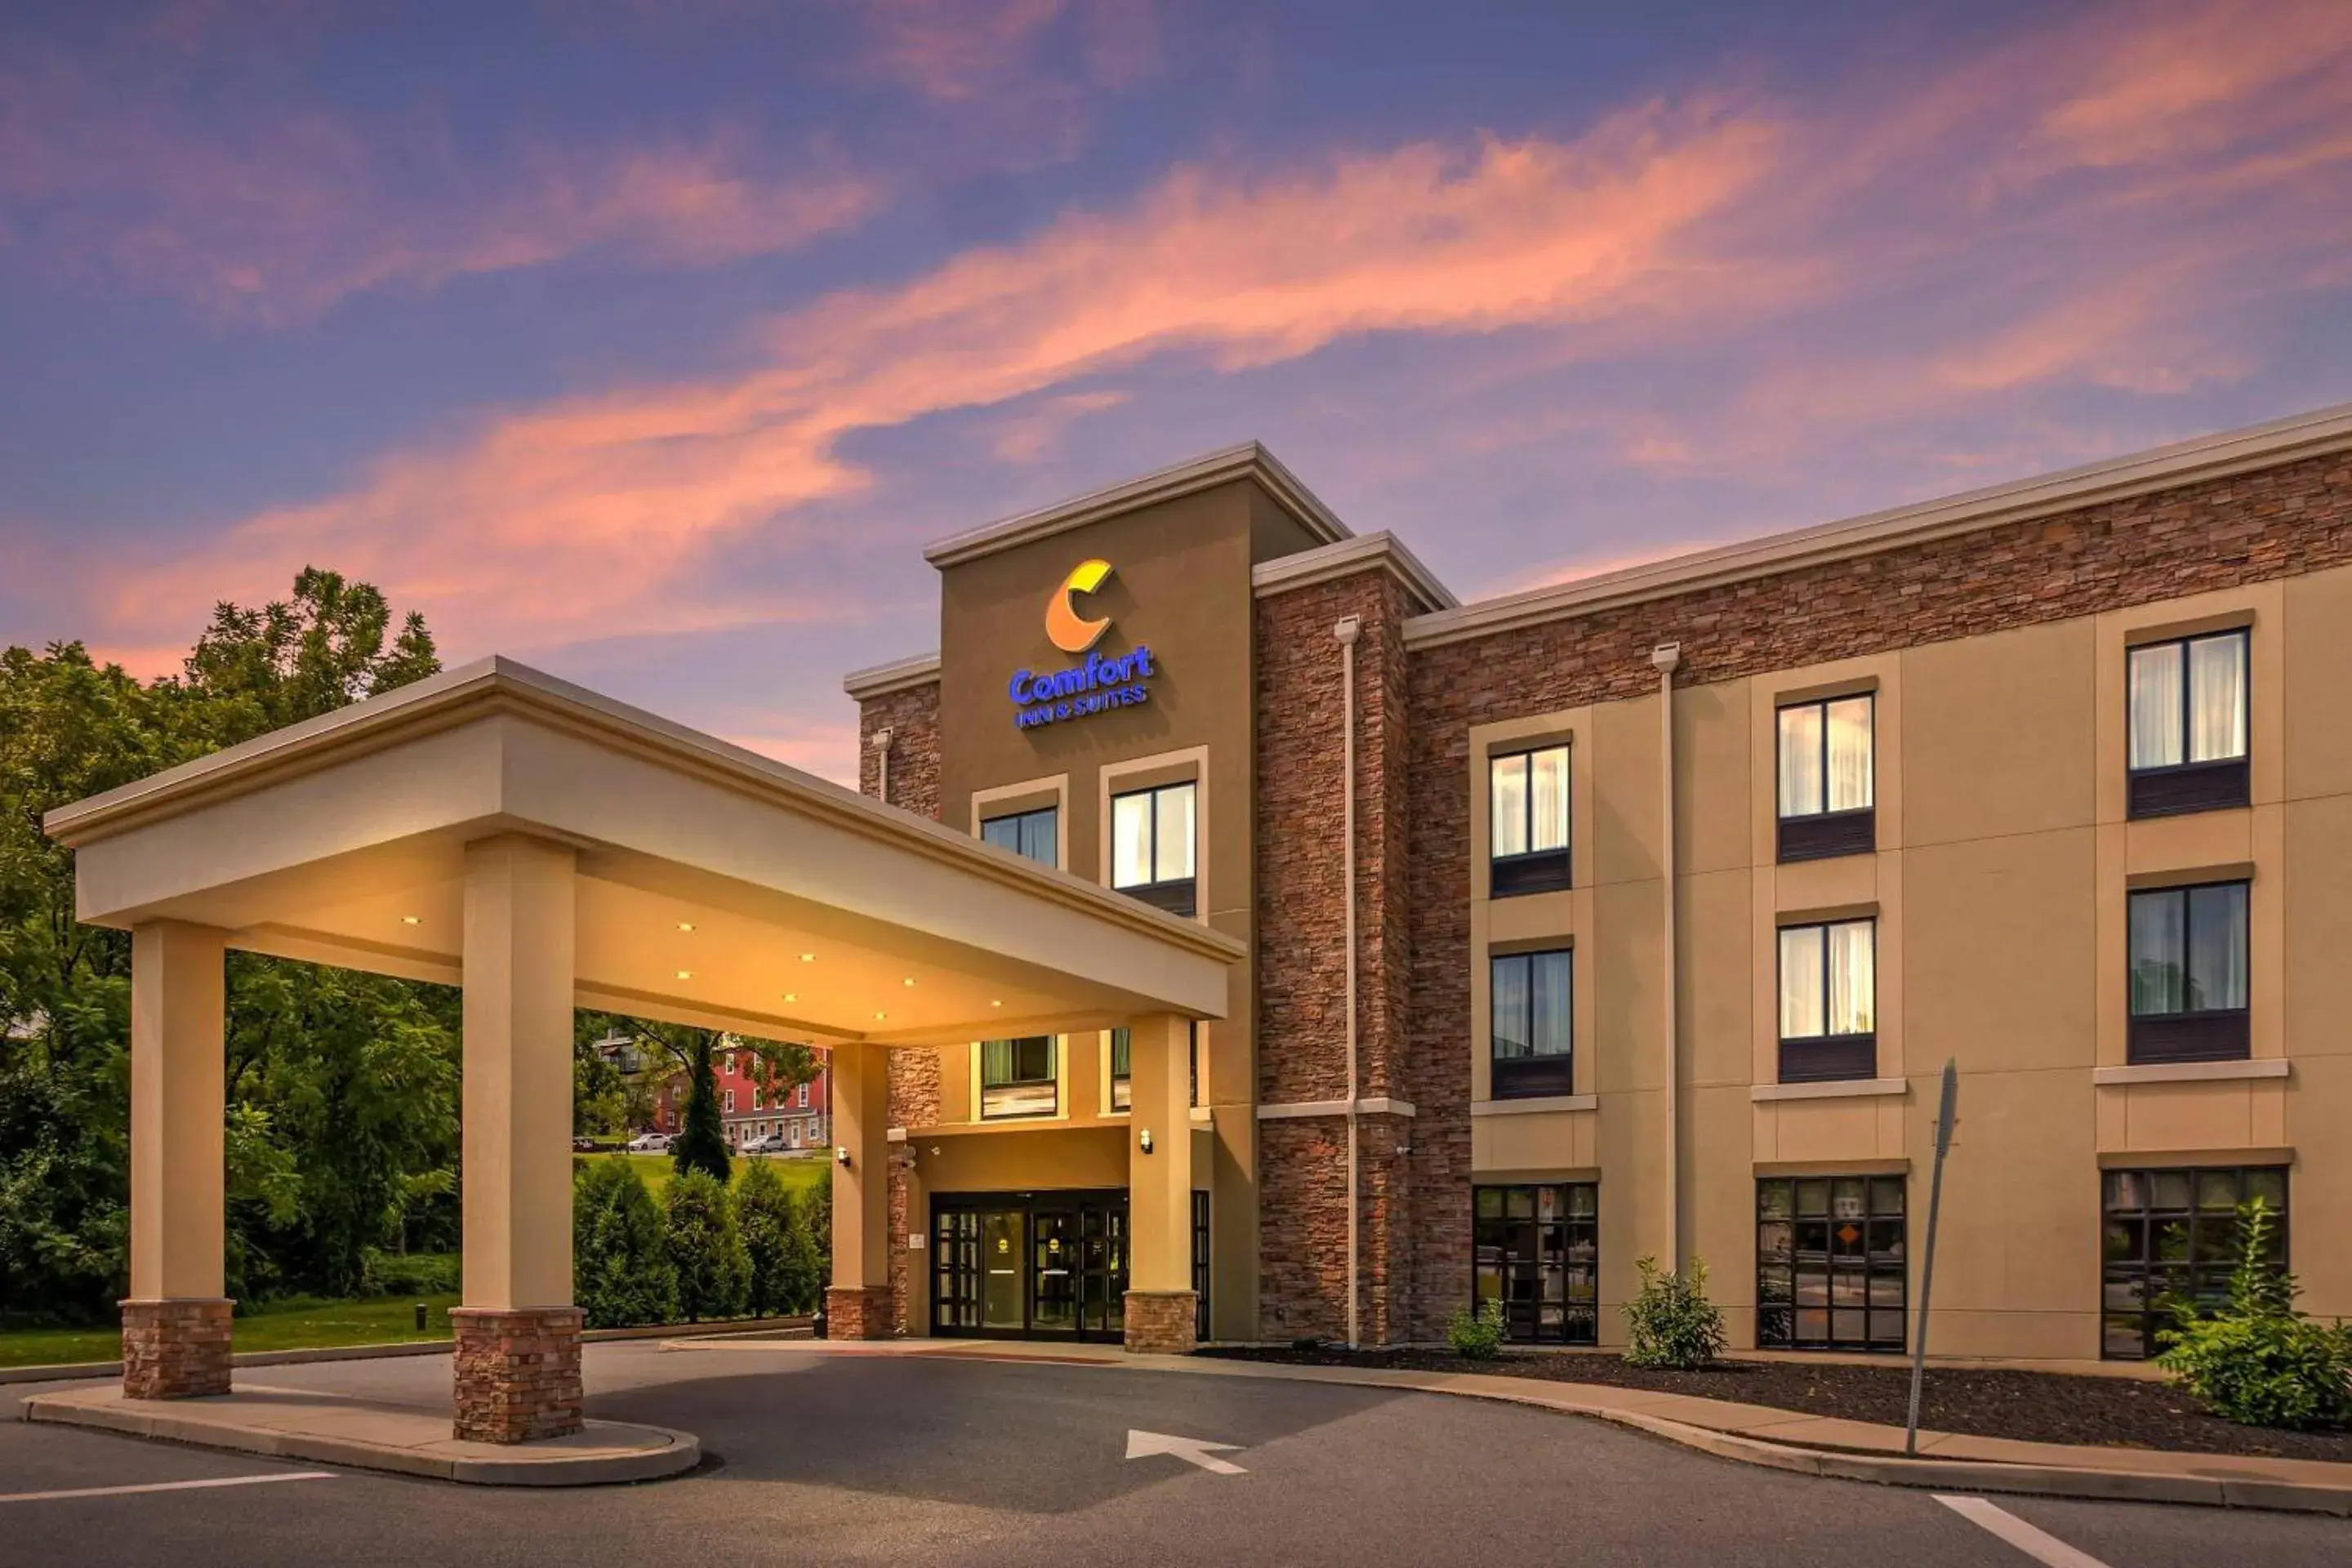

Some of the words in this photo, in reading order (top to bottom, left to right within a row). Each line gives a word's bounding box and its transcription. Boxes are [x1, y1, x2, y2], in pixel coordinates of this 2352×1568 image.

[1009, 646, 1153, 705] Comfort
[1015, 705, 1054, 728] INN
[1056, 703, 1071, 719] &
[1074, 684, 1147, 715] SUITES
